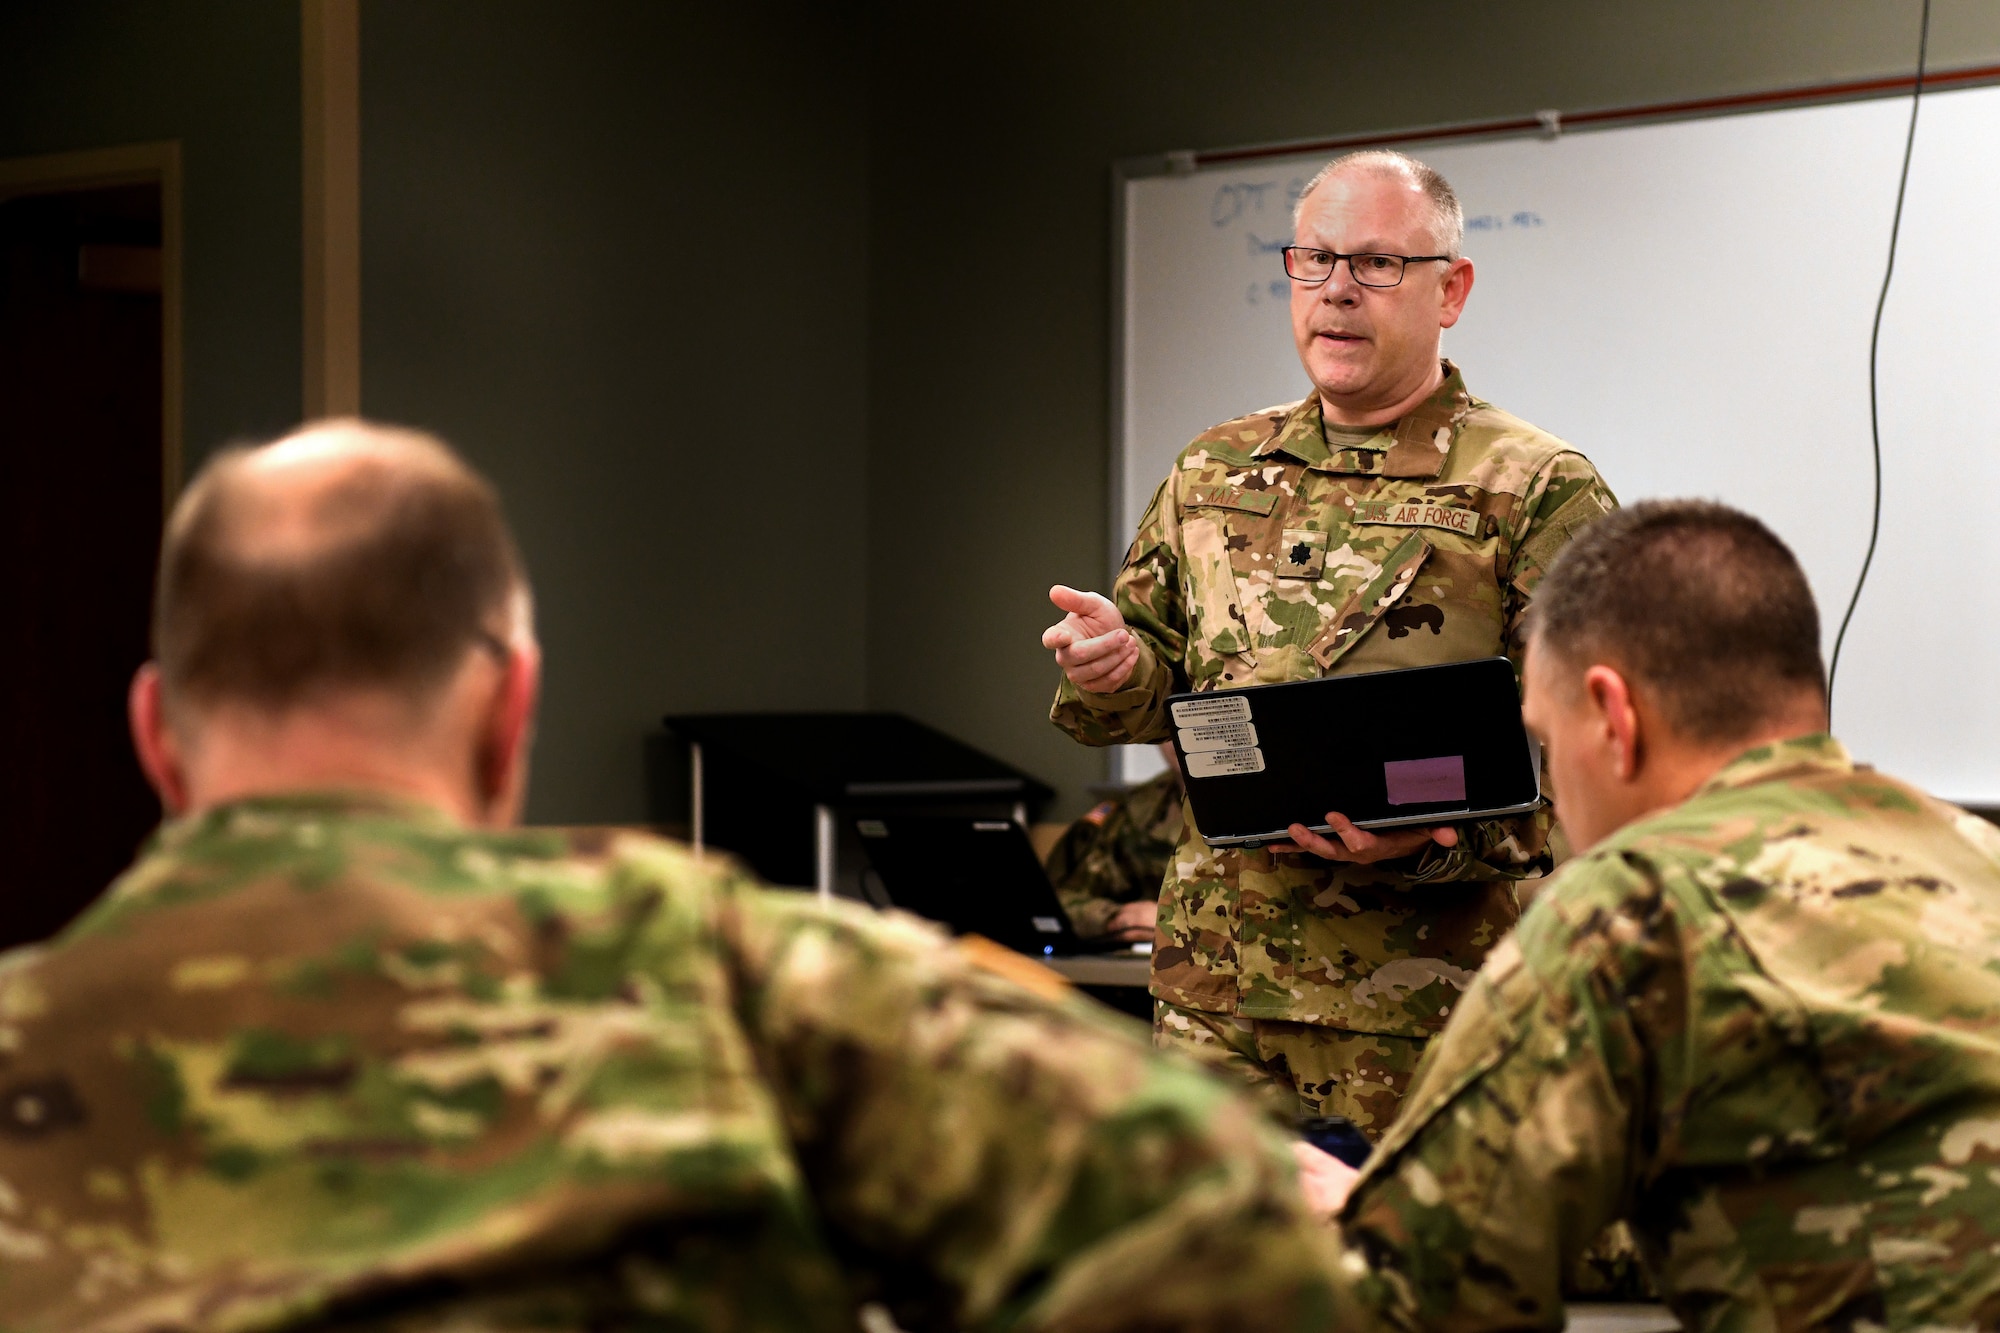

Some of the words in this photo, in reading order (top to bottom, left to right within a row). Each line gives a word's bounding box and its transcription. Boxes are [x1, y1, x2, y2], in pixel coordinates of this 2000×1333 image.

[1206, 487, 1245, 505] KATZ
[1364, 504, 1388, 522] U.S.
[1394, 506, 1419, 523] AIR
[1423, 507, 1470, 531] FORCE
